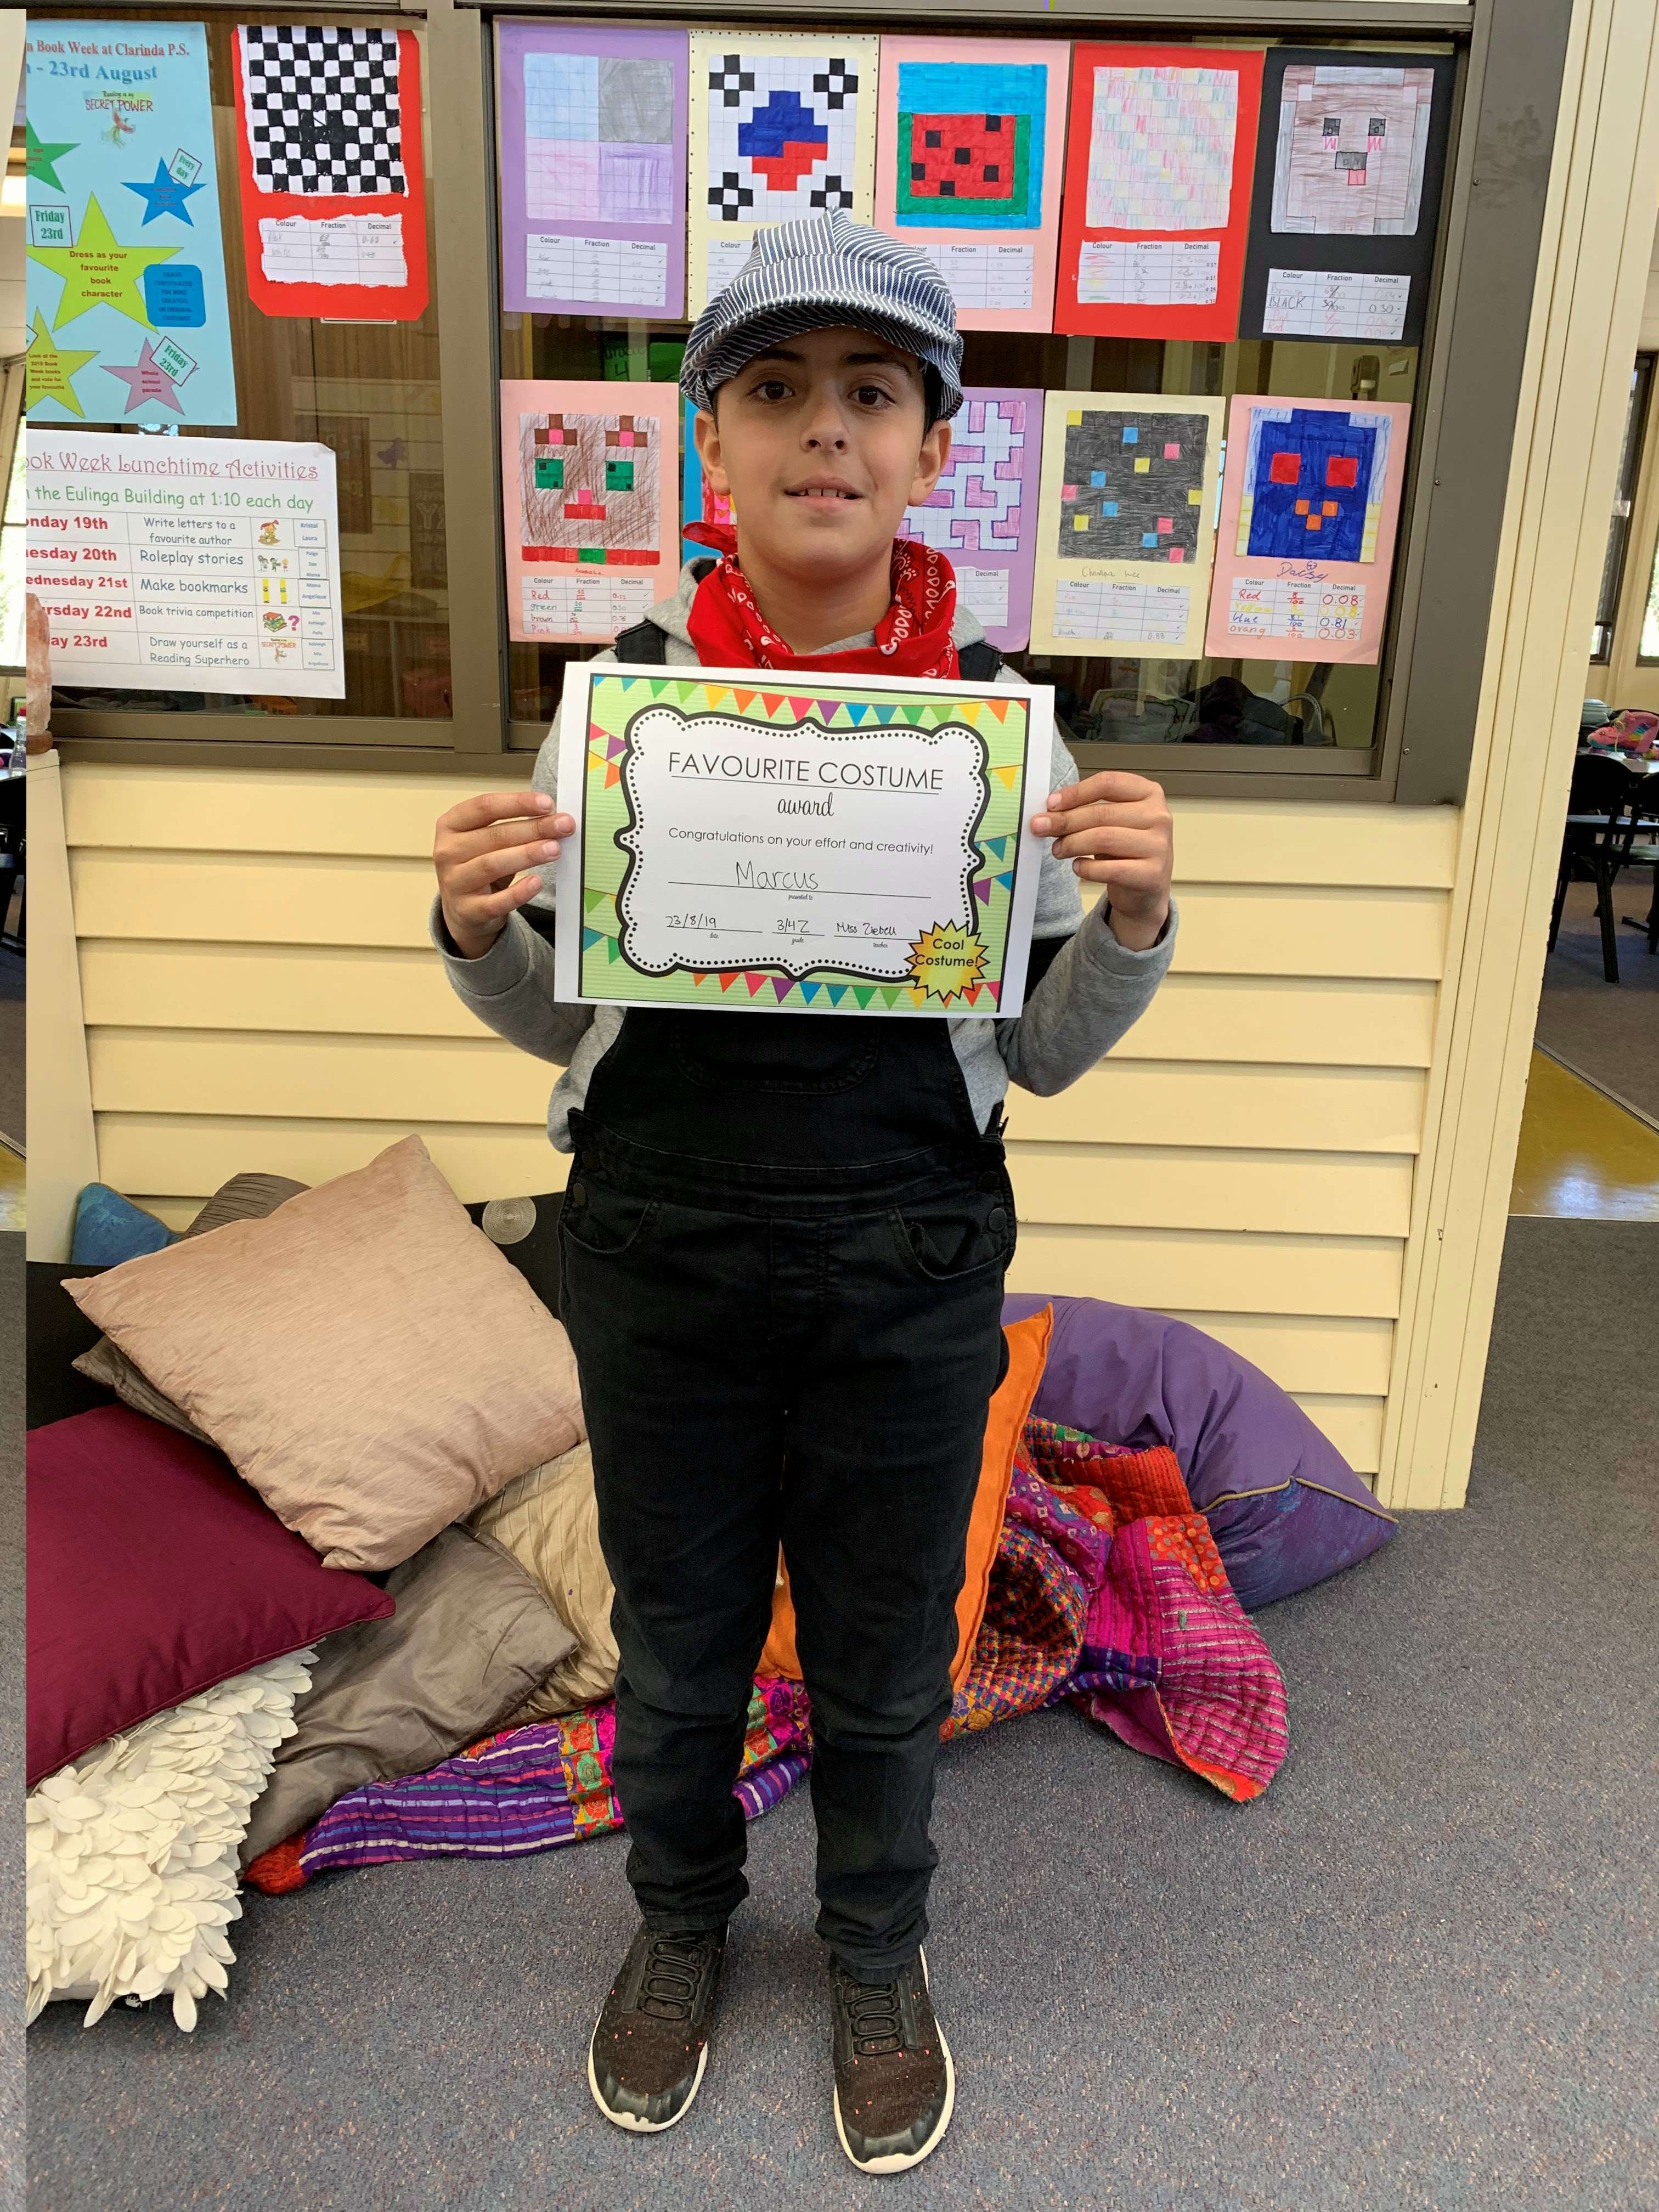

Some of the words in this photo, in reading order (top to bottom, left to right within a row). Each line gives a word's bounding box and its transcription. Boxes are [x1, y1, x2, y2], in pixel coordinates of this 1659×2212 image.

[37, 40, 64, 53] Book
[67, 41, 98, 54] Week
[101, 43, 112, 55] at
[116, 43, 164, 56] Clarinda
[167, 43, 189, 55] P.S.
[49, 61, 89, 78] 23rd
[95, 64, 157, 84] August
[86, 99, 115, 110] SECRET
[117, 99, 153, 112] POWER
[179, 155, 194, 170] Every
[176, 167, 188, 179] day
[35, 211, 64, 223] Friday
[41, 228, 63, 239] 23rd
[1269, 296, 1306, 309] BLACK
[164, 344, 188, 369] Friday
[159, 358, 179, 377] 23rd
[59, 452, 112, 472] Week
[118, 454, 220, 477] Lunchtime
[225, 459, 318, 480] Activities
[35, 486, 61, 500] the
[66, 486, 119, 506] Eulinga
[125, 488, 184, 509] Building
[190, 493, 205, 506] at
[212, 492, 240, 506] 1:10
[247, 493, 281, 508] each
[287, 494, 313, 514] day
[74, 517, 108, 529] 19th
[143, 517, 174, 527] Write
[178, 518, 212, 529] letters
[216, 521, 227, 529] to
[150, 533, 196, 544] favourite
[199, 535, 232, 545] author
[83, 549, 117, 561] 20th
[140, 550, 193, 567] Roleplay
[198, 553, 244, 565] stories
[98, 577, 128, 588] 21st
[140, 579, 175, 591] Make
[179, 579, 248, 594] bookmarks
[531, 590, 550, 600] Red
[1239, 589, 1261, 600] Red
[1323, 594, 1358, 606] 0.08
[42, 605, 89, 619] rsday
[94, 605, 132, 618] 22nd
[139, 605, 163, 615] Book
[166, 607, 193, 616] trivia
[196, 608, 253, 619] competition
[531, 613, 553, 622] brown
[1233, 612, 1257, 623] blue
[1320, 617, 1347, 629] 0.81
[1318, 628, 1355, 639] 0.03
[74, 635, 108, 647] 23rd
[150, 636, 176, 647] Draw
[180, 639, 223, 650] yourself
[150, 652, 191, 667] Reading
[195, 654, 250, 667] Superhero
[669, 752, 810, 781] FAVOURITE
[819, 762, 944, 790] COSTUME
[777, 792, 834, 816] award
[669, 827, 764, 844] Congratulations
[786, 837, 812, 847] your
[815, 838, 847, 848] effort
[850, 840, 873, 850] and
[877, 843, 933, 855] creativity!
[736, 860, 819, 890] Marcus
[665, 913, 716, 929] 23/8/19
[837, 922, 857, 934] Miss
[933, 939, 964, 950] Cool
[915, 954, 978, 967] Costume!
